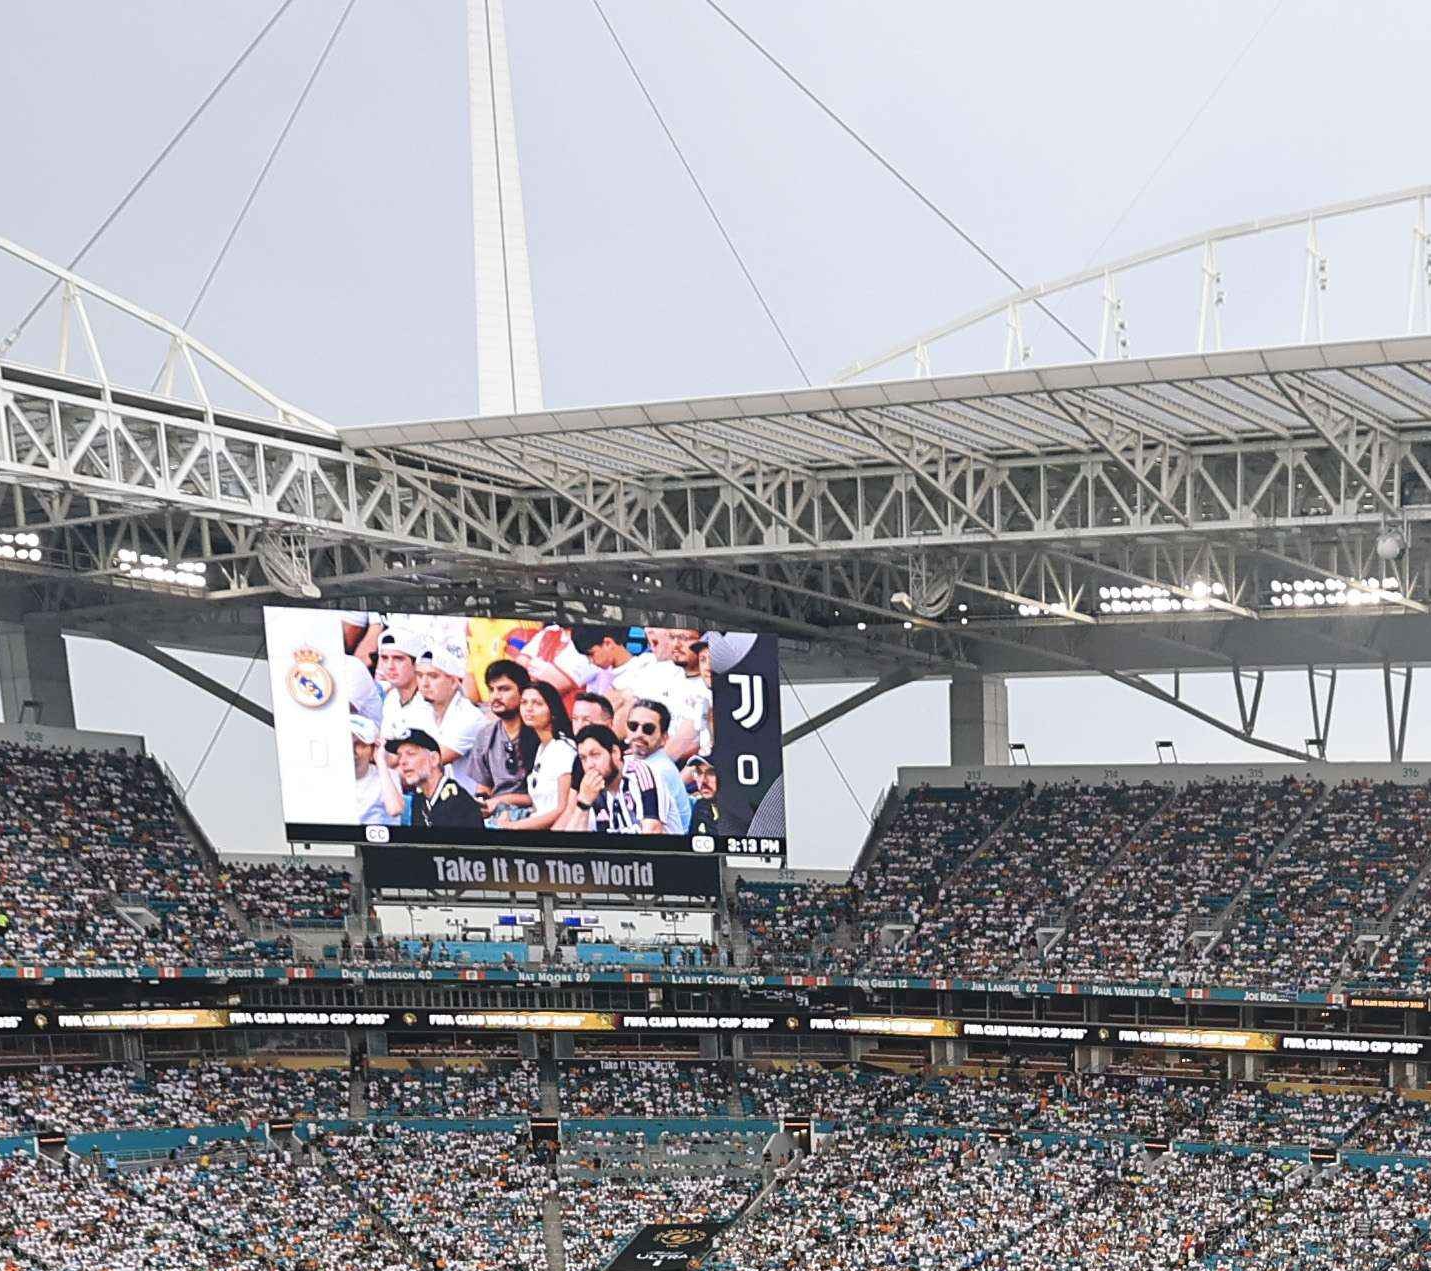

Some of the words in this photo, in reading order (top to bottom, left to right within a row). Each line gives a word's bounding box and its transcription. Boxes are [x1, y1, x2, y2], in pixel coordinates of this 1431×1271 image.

[737, 754, 759, 785] 0
[727, 838, 756, 852] 3:13
[759, 839, 780, 853] PM
[433, 856, 486, 882] Take
[492, 857, 509, 883] It
[514, 858, 539, 883] To
[545, 860, 585, 885] The
[591, 860, 654, 886] World
[671, 974, 702, 984] LARRY
[750, 975, 765, 985] 39
[1026, 983, 1038, 993] 62
[1092, 986, 1111, 996] PAUL
[1158, 988, 1170, 998] 42
